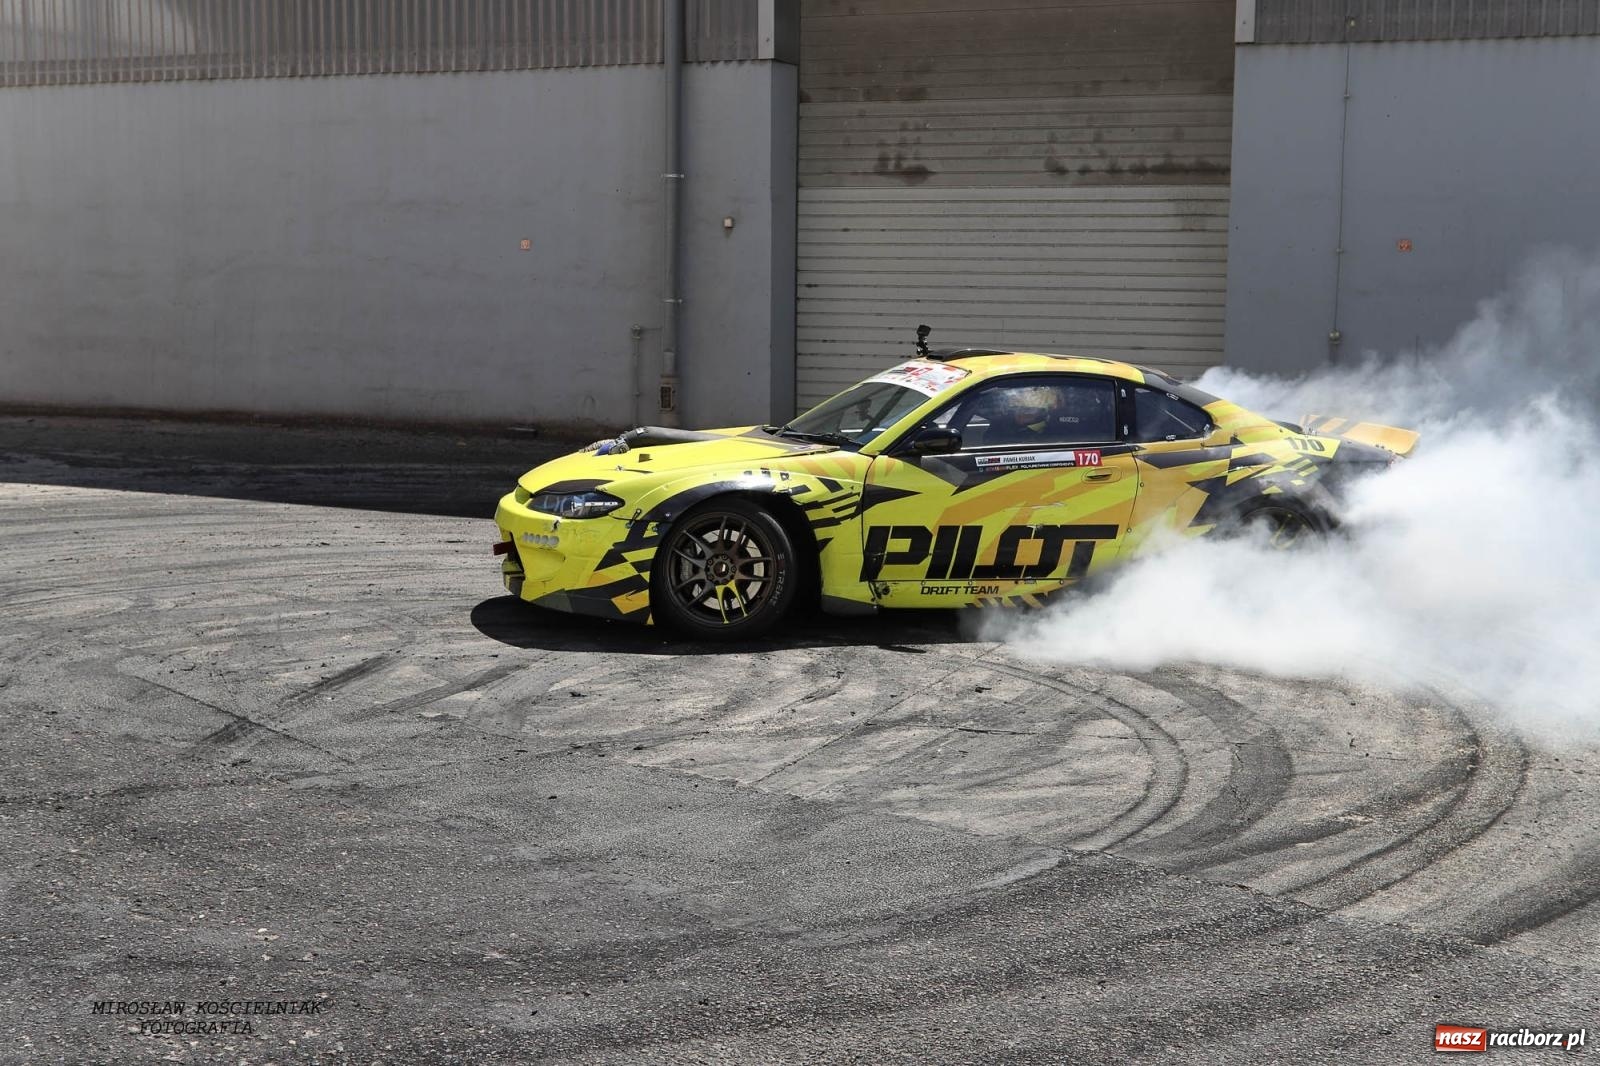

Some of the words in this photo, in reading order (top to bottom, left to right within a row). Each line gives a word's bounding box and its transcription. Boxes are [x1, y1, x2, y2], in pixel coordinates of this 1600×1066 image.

[1284, 437, 1325, 451] 170
[1077, 453, 1099, 466] 170
[860, 525, 1119, 582] PILOT
[920, 585, 961, 595] DRIFT
[962, 585, 999, 595] TEAM
